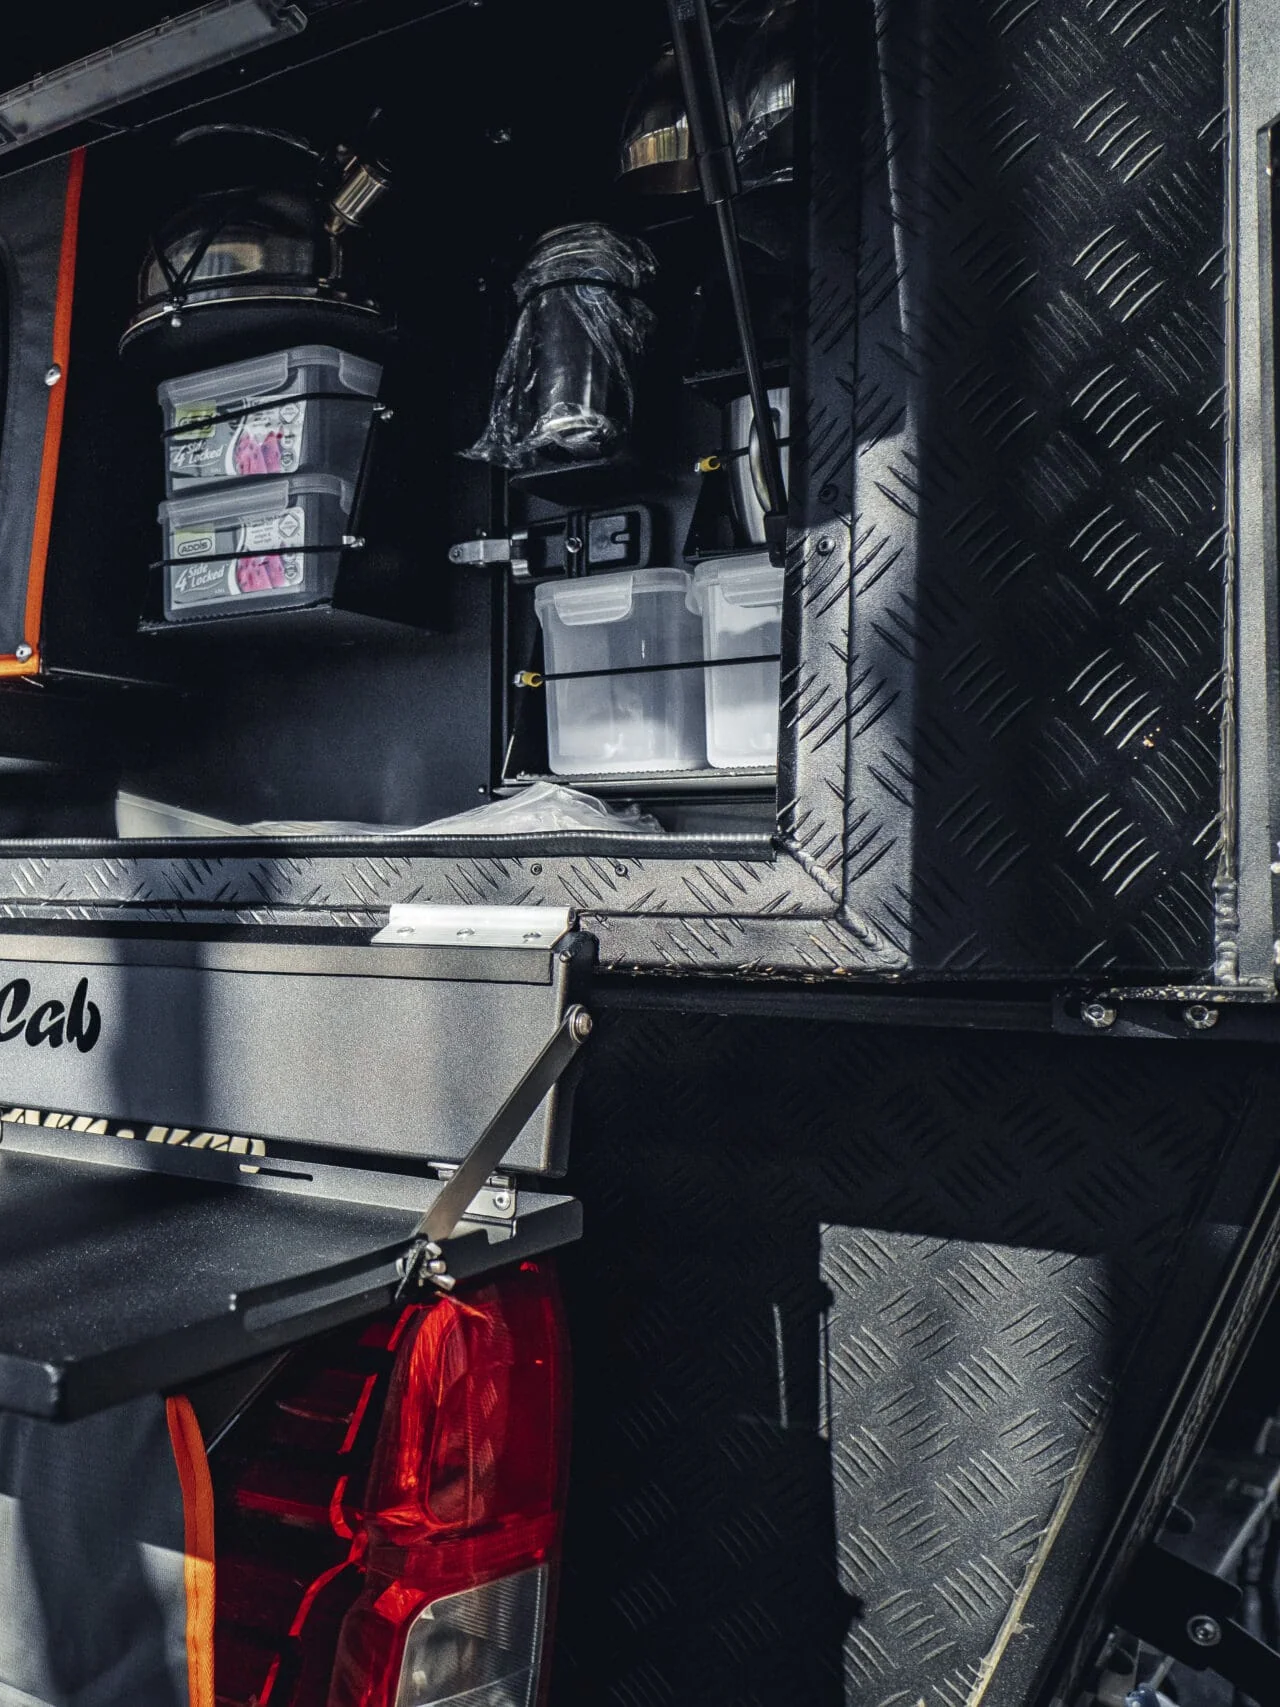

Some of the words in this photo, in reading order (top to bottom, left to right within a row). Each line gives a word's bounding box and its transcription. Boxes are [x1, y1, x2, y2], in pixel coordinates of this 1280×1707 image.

[188, 444, 224, 464] Locked
[175, 568, 188, 592] 4
[188, 563, 209, 578] Side
[191, 564, 226, 588] Locked
